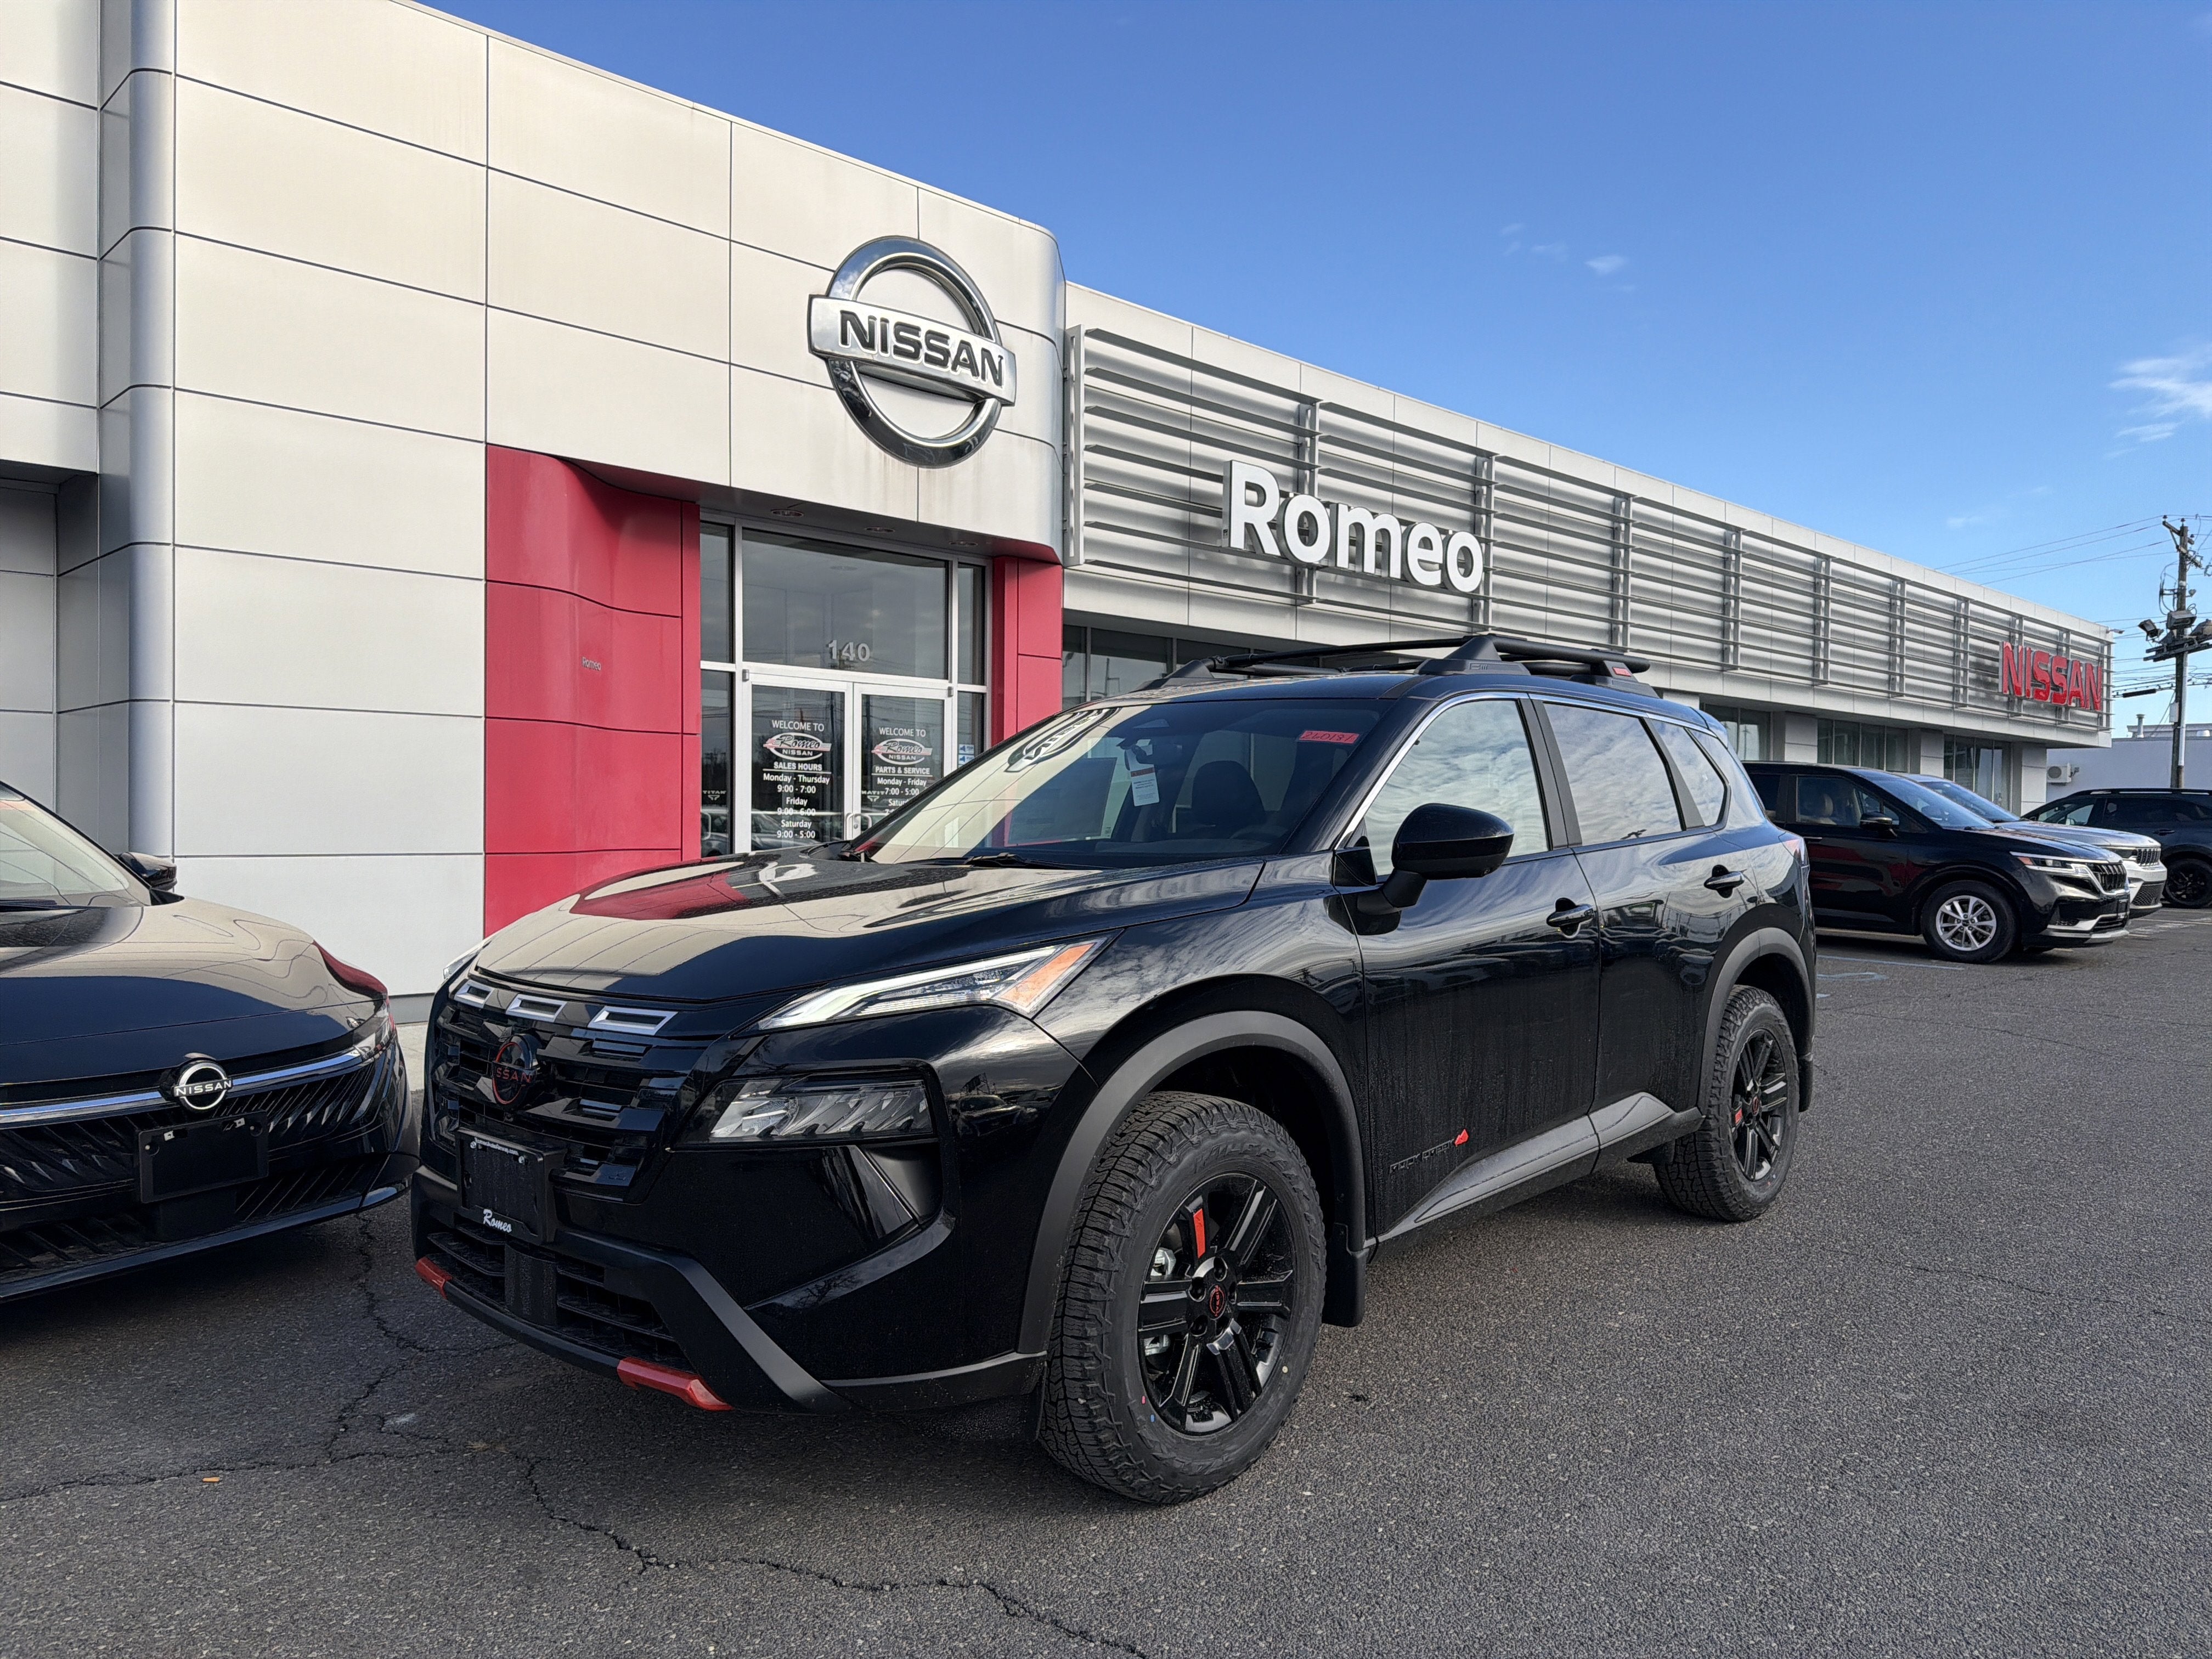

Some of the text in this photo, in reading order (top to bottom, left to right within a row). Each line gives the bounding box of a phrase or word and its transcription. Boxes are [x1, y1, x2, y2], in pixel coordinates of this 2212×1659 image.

[839, 309, 1005, 388] NISSAN
[1224, 460, 1483, 592] Romeo
[827, 640, 870, 662] 140
[2001, 641, 2103, 712] NISSAN
[771, 720, 825, 732] WELCOME TO
[879, 727, 926, 737] WELCOME TO
[776, 735, 821, 749] Romeo
[883, 740, 923, 753] Romeo
[774, 761, 797, 770] SALES
[763, 773, 792, 783] Monday
[798, 774, 830, 785] Thursday
[877, 777, 902, 787] Monday
[907, 778, 927, 787] Friday
[777, 784, 794, 793] 9:00
[800, 785, 816, 793] 7:00
[884, 787, 899, 795] 7:00
[786, 797, 808, 806] Friday
[777, 807, 794, 816] 9:00
[799, 808, 816, 816] 6:00
[781, 819, 812, 829] Saturday
[776, 830, 793, 838] 9:00
[799, 830, 816, 838] 5:00
[496, 1067, 532, 1084] SSAN
[176, 1080, 232, 1096] NISSAN
[483, 1209, 512, 1233] Romeo
